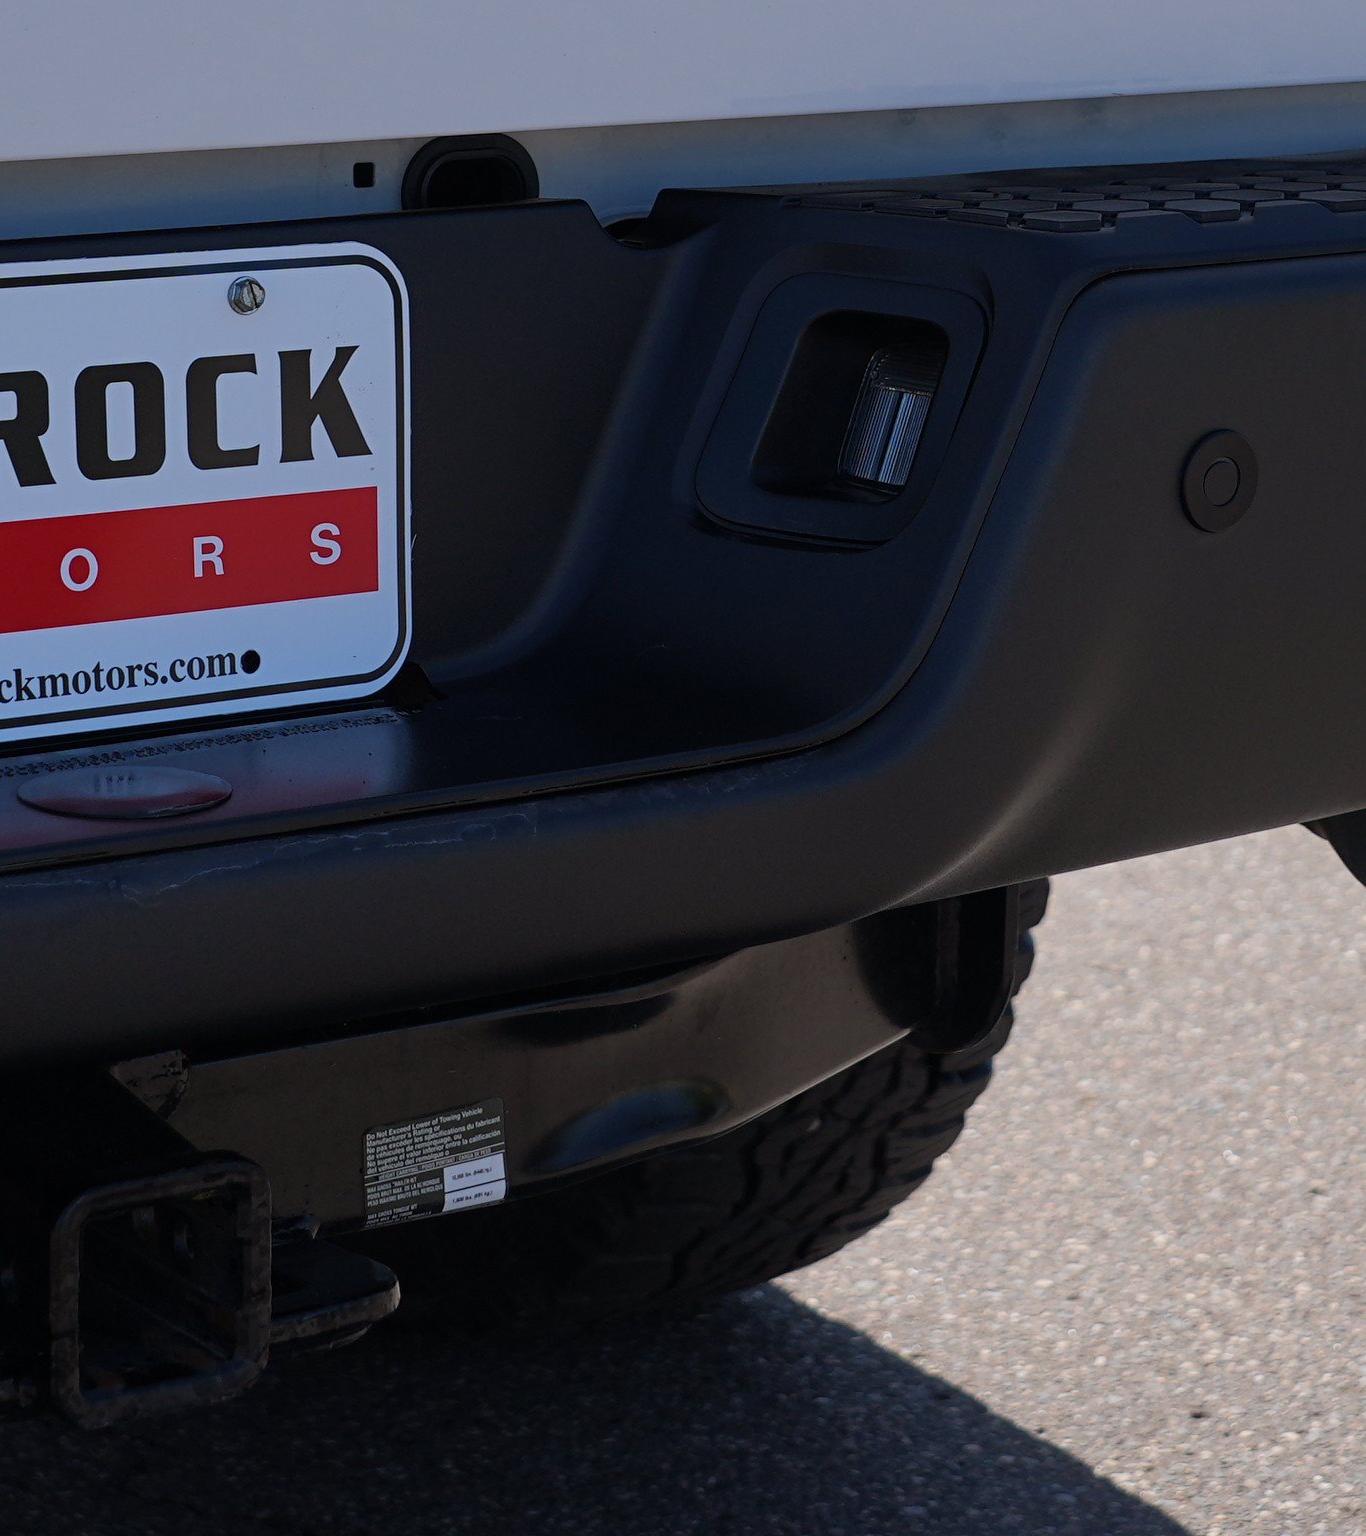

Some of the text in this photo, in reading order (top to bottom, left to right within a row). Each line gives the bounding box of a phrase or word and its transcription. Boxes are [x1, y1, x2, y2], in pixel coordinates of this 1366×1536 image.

[367, 1107, 483, 1141] Do Not Exceed Lower of Towing Vehicle
[467, 1122, 474, 1131] du
